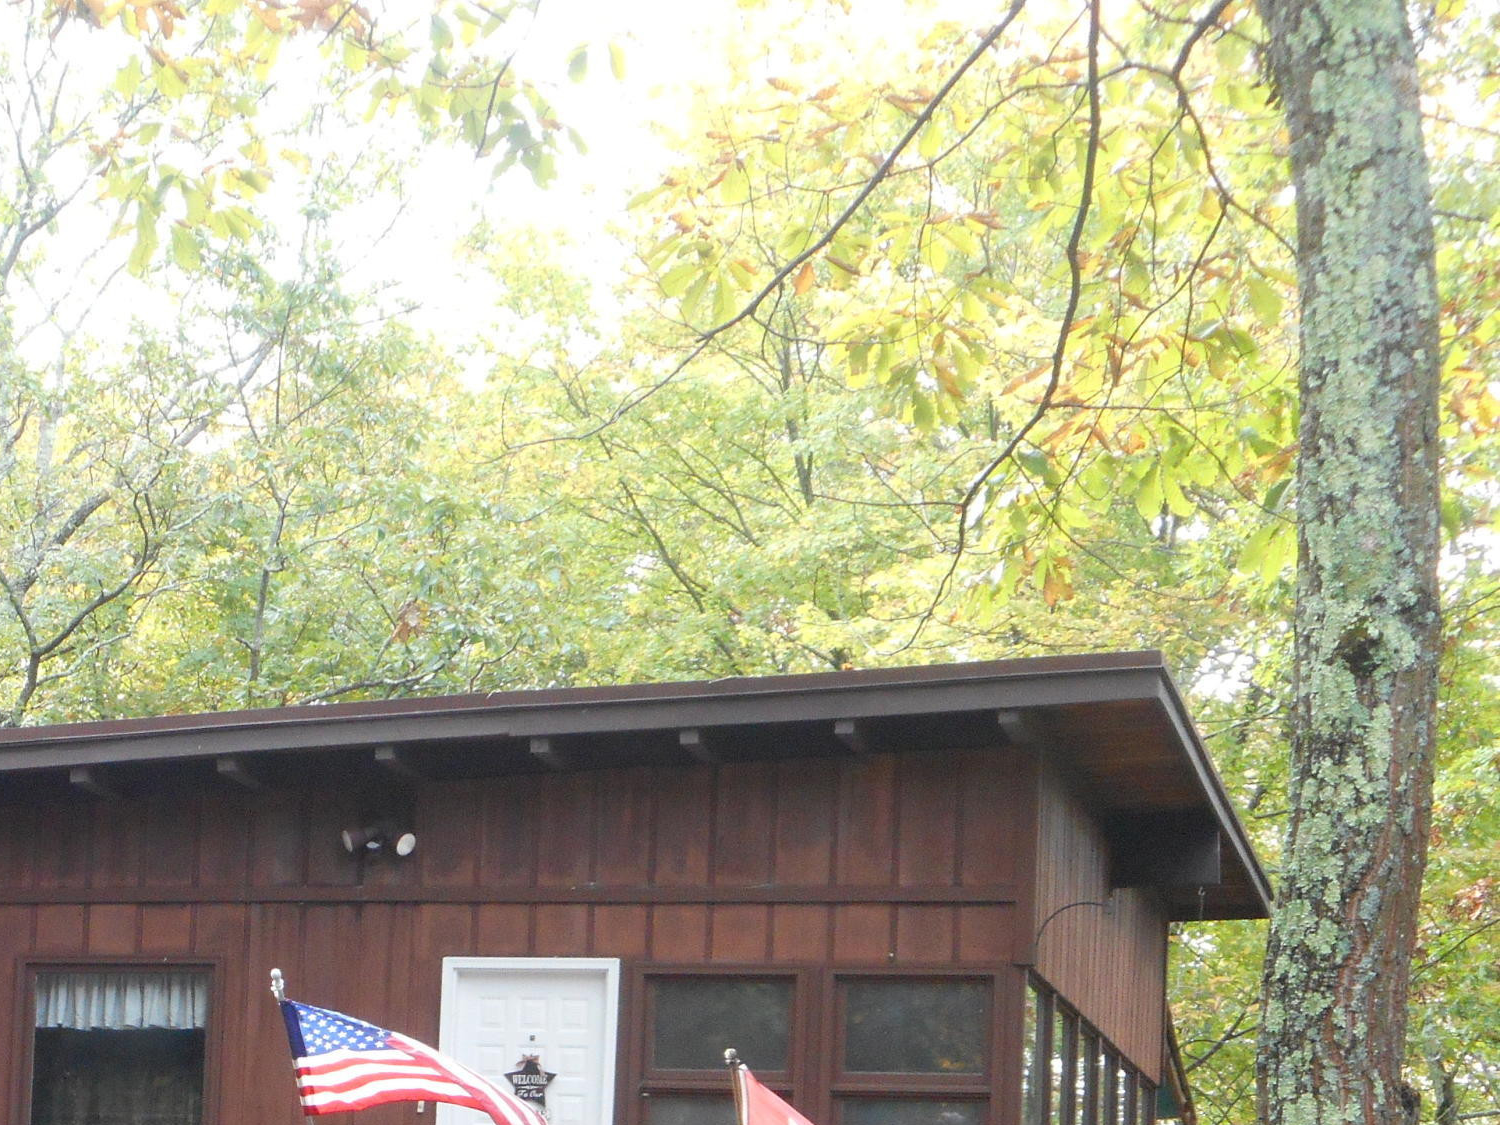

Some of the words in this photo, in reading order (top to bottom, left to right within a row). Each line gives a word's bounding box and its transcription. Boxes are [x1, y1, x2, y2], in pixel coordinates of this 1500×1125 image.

[513, 1074, 548, 1085] WELCOME
[517, 1089, 528, 1098] To
[529, 1090, 543, 1098] Our
